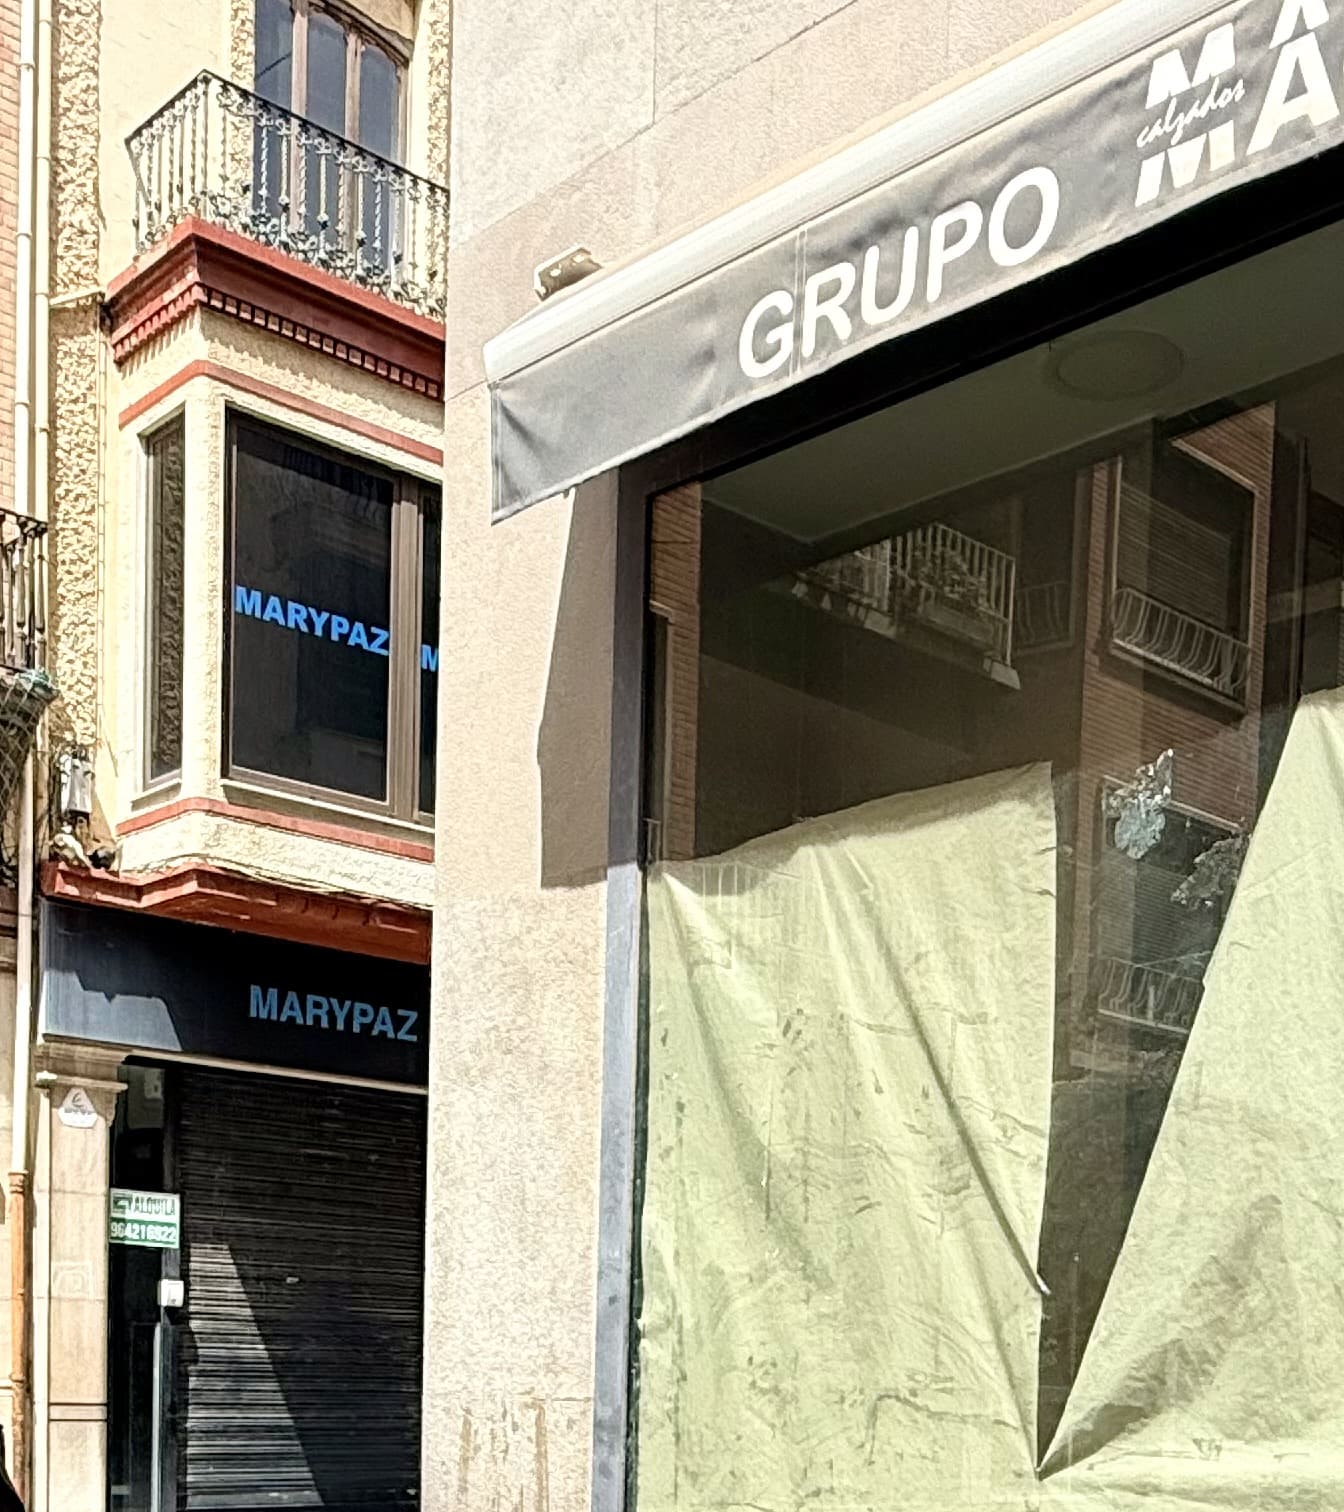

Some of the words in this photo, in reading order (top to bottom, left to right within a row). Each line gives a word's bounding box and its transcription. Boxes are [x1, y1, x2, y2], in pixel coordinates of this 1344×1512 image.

[1136, 77, 1246, 148] calzados
[739, 165, 1061, 379] GRUPO
[235, 584, 390, 656] MARYPAZ
[248, 983, 419, 1042] MARYPAZ
